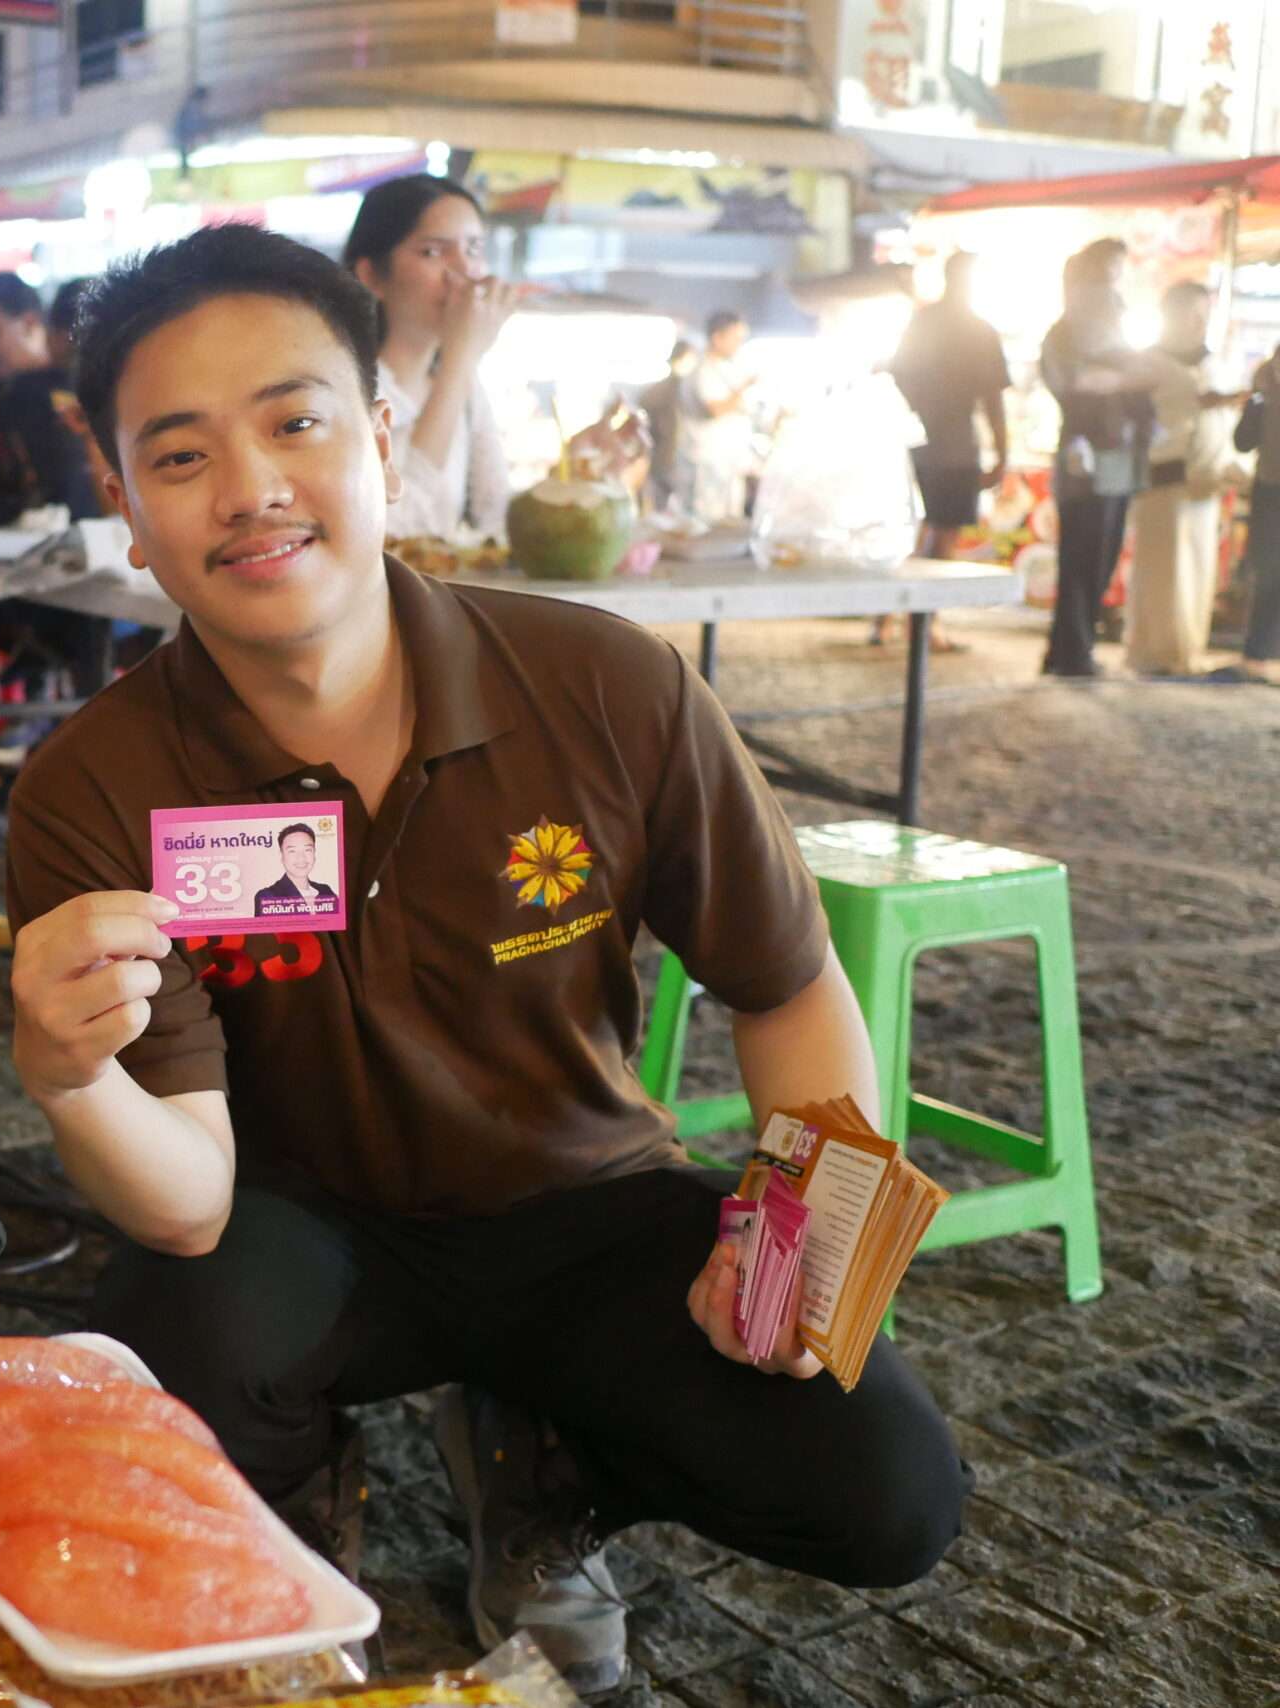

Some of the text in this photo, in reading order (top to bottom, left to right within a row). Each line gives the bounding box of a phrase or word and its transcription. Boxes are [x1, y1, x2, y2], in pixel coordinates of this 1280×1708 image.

[210, 830, 273, 848] หาดใหญ่
[175, 863, 242, 904] 33
